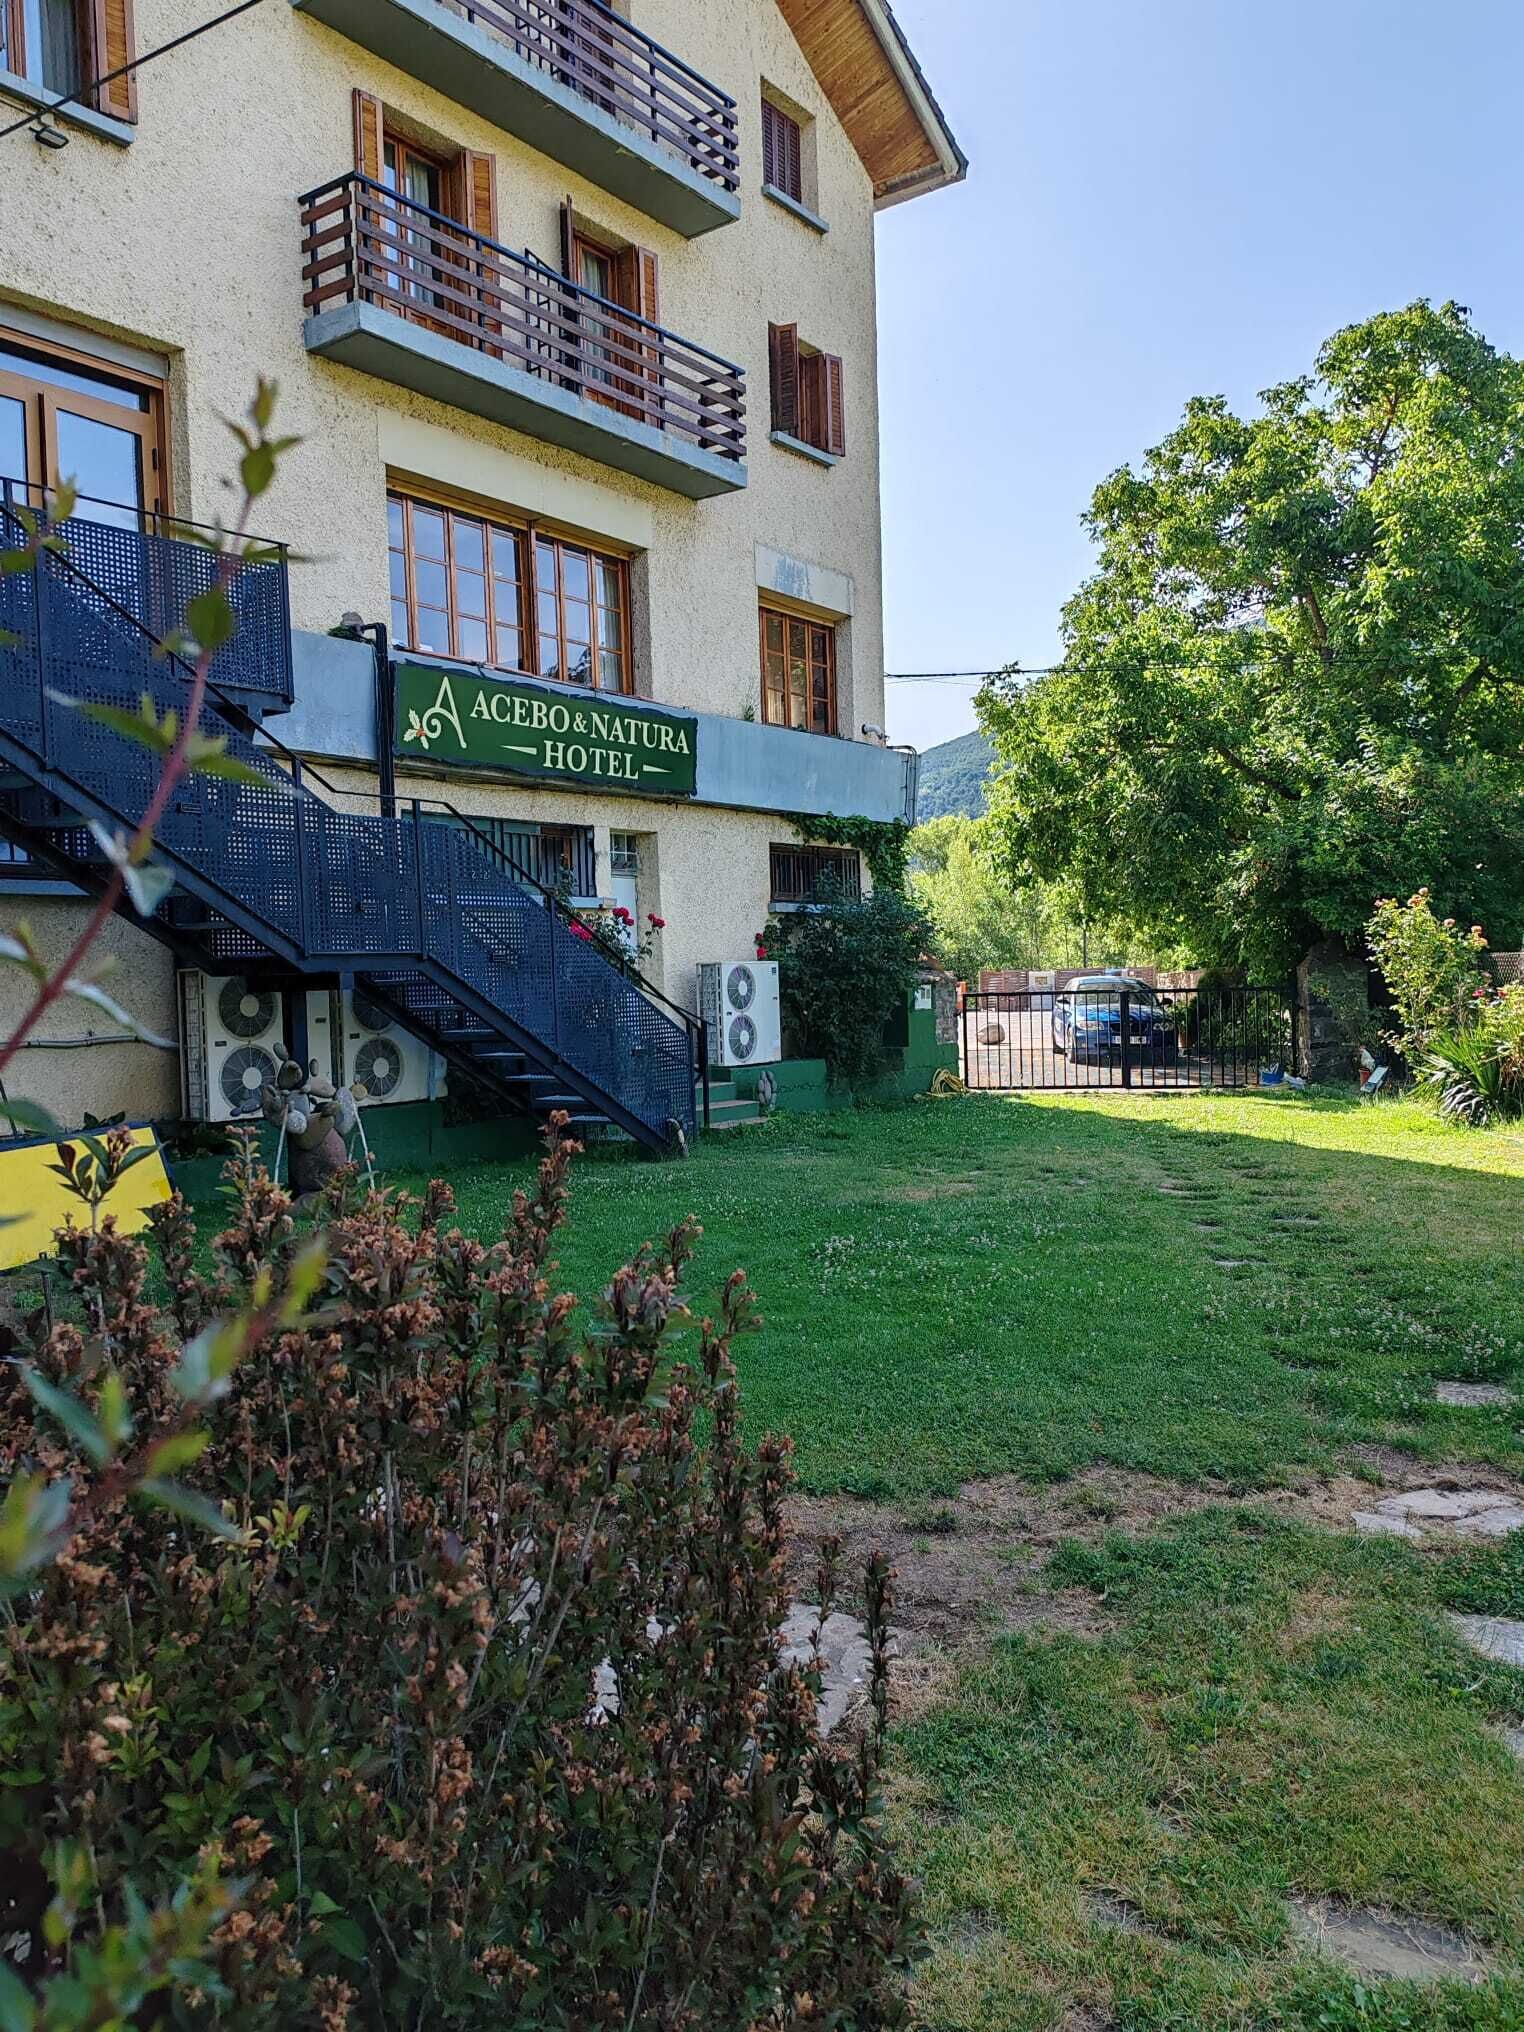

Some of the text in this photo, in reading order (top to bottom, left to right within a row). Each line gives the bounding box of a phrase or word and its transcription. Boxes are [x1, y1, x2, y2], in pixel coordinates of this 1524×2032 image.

[470, 690, 570, 733] ACEBO
[590, 711, 691, 754] NATURA
[543, 740, 639, 779] HOTEL
